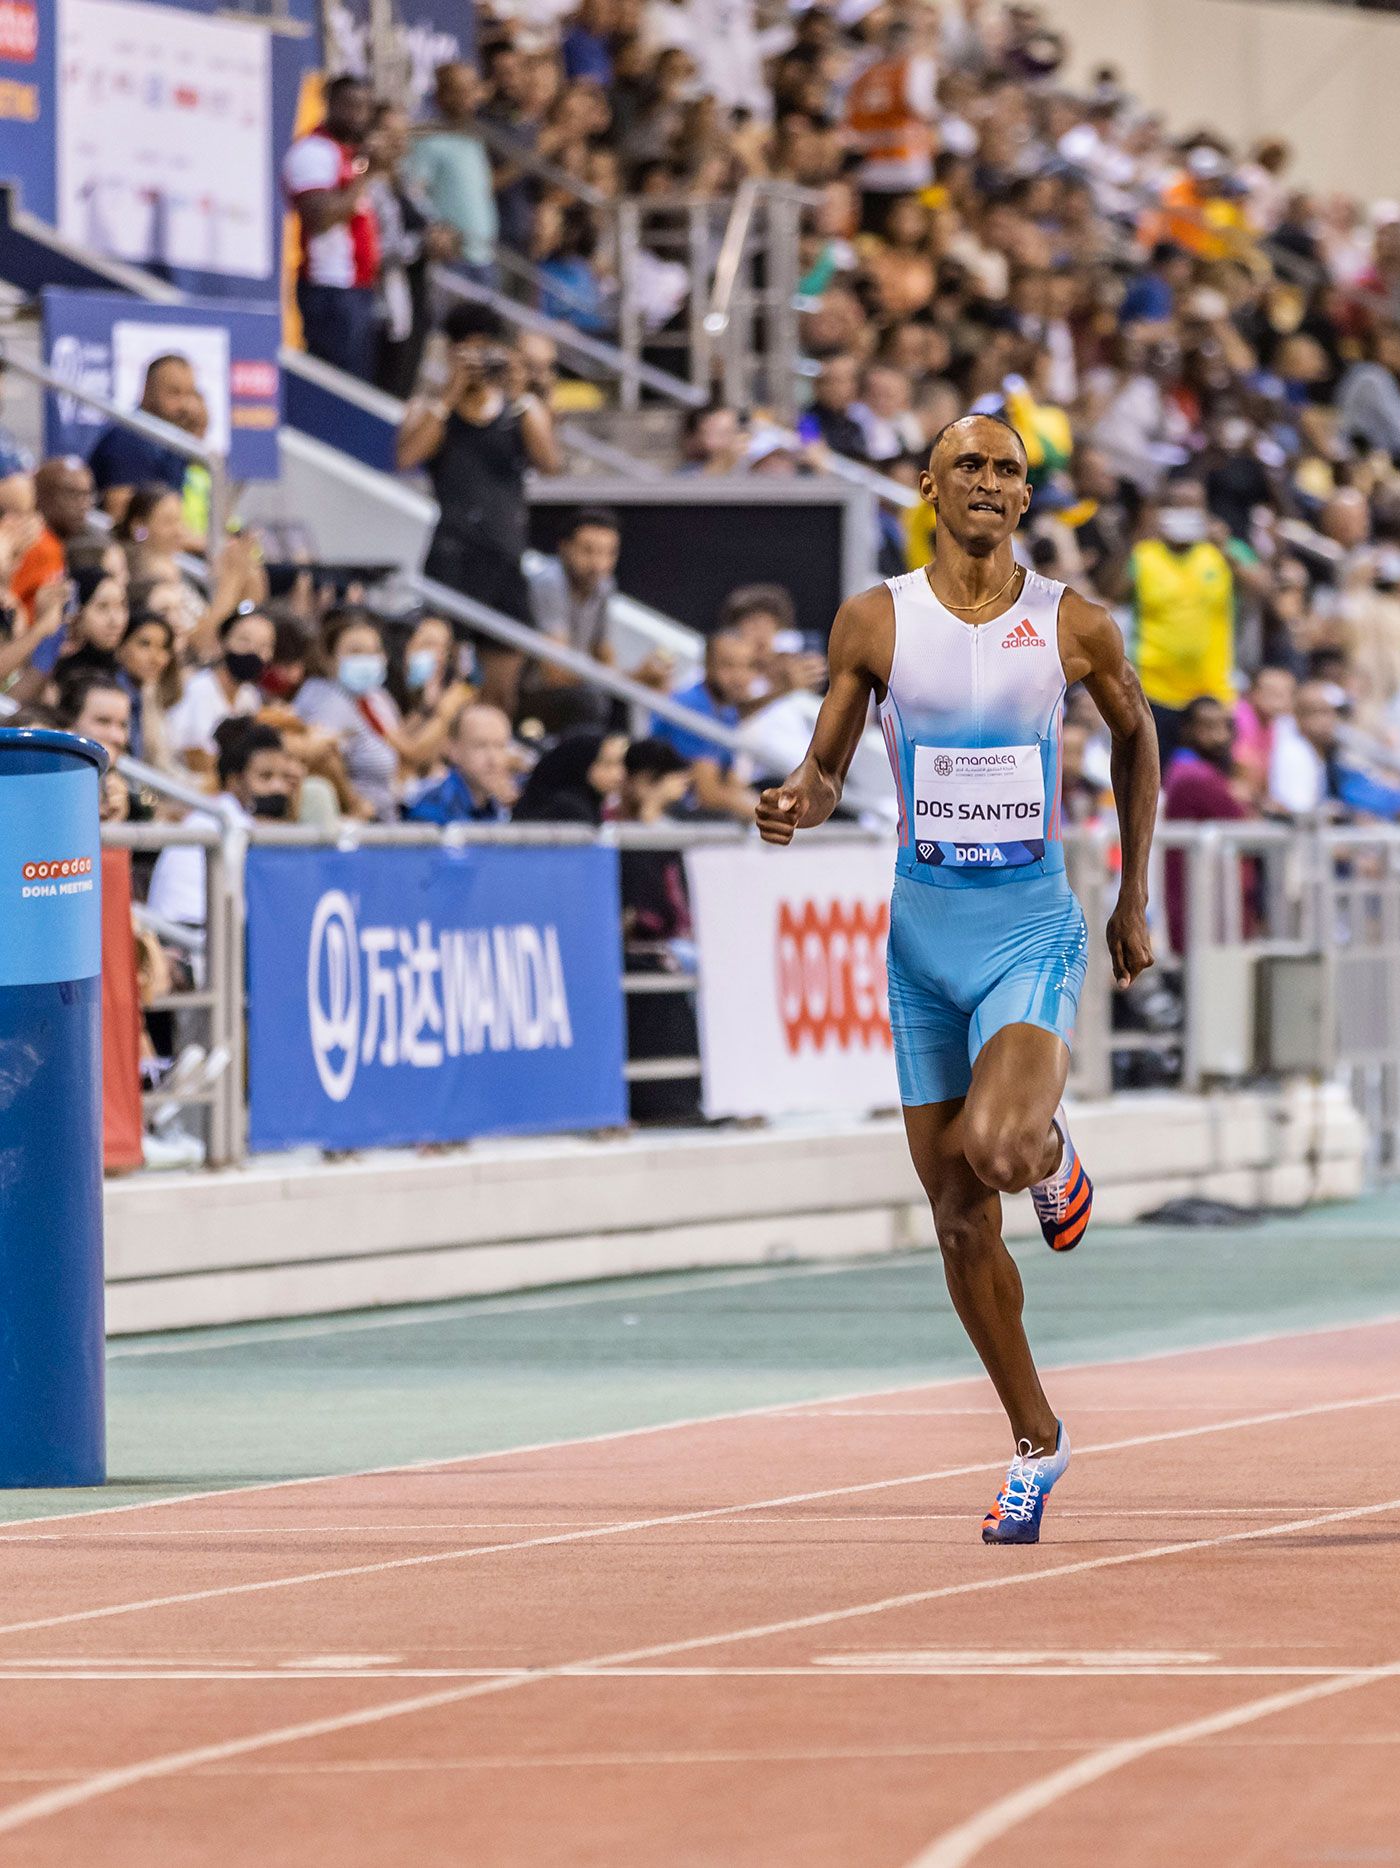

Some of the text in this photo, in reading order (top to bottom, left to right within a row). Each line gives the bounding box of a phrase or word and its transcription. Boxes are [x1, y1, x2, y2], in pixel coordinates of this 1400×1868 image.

[1001, 636, 1046, 649] adidas
[955, 753, 1018, 769] manateq
[915, 799, 1041, 820] DOS SANTOS
[955, 846, 1004, 862] DOHA
[24, 858, 92, 879] ooredoo
[21, 880, 94, 898] DOHA MEETING
